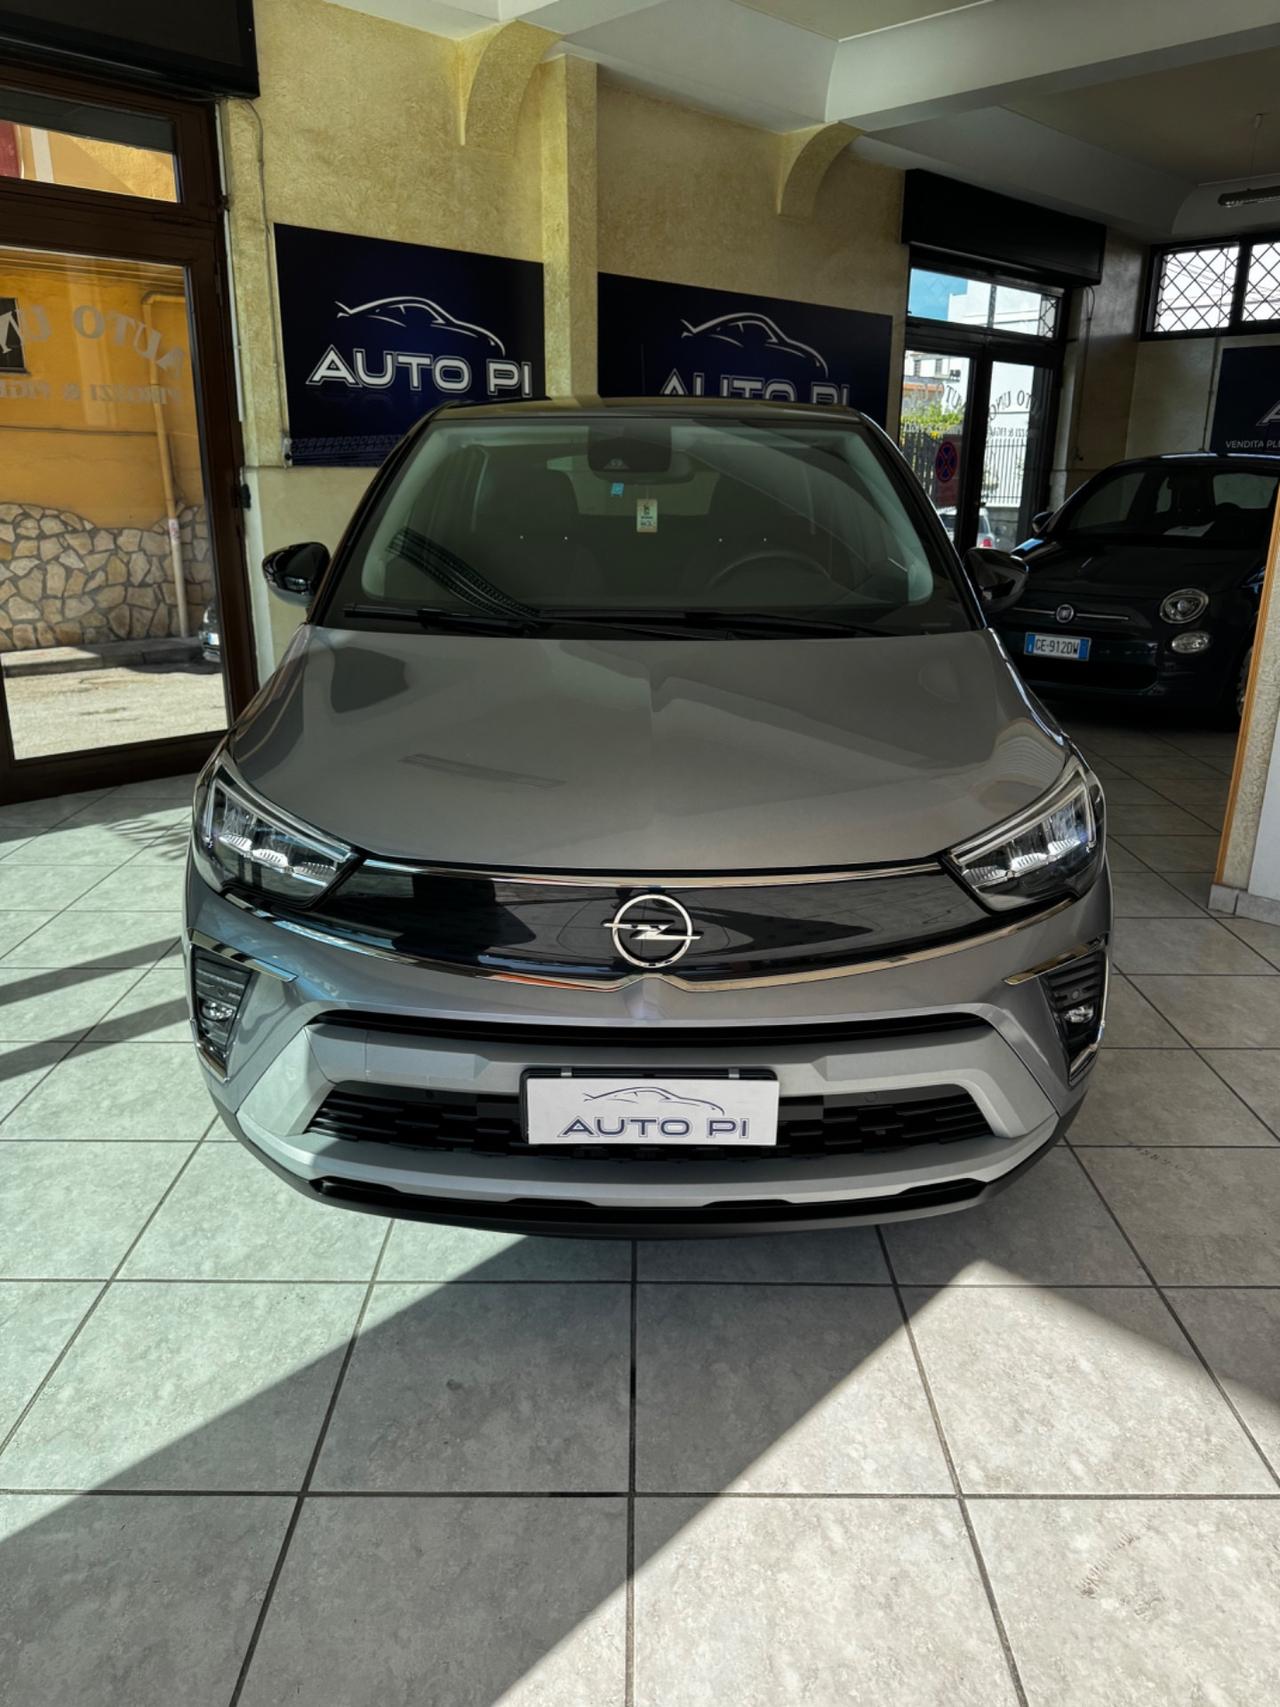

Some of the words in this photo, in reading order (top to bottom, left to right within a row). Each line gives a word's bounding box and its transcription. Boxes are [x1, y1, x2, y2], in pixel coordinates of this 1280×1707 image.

[306, 344, 472, 393] AUTO
[486, 359, 532, 397] PI
[660, 368, 797, 401] AUTO
[811, 382, 849, 406] PI
[1225, 440, 1264, 449] VENDITA
[557, 1115, 692, 1138] AUTO
[706, 1117, 750, 1138] PI
